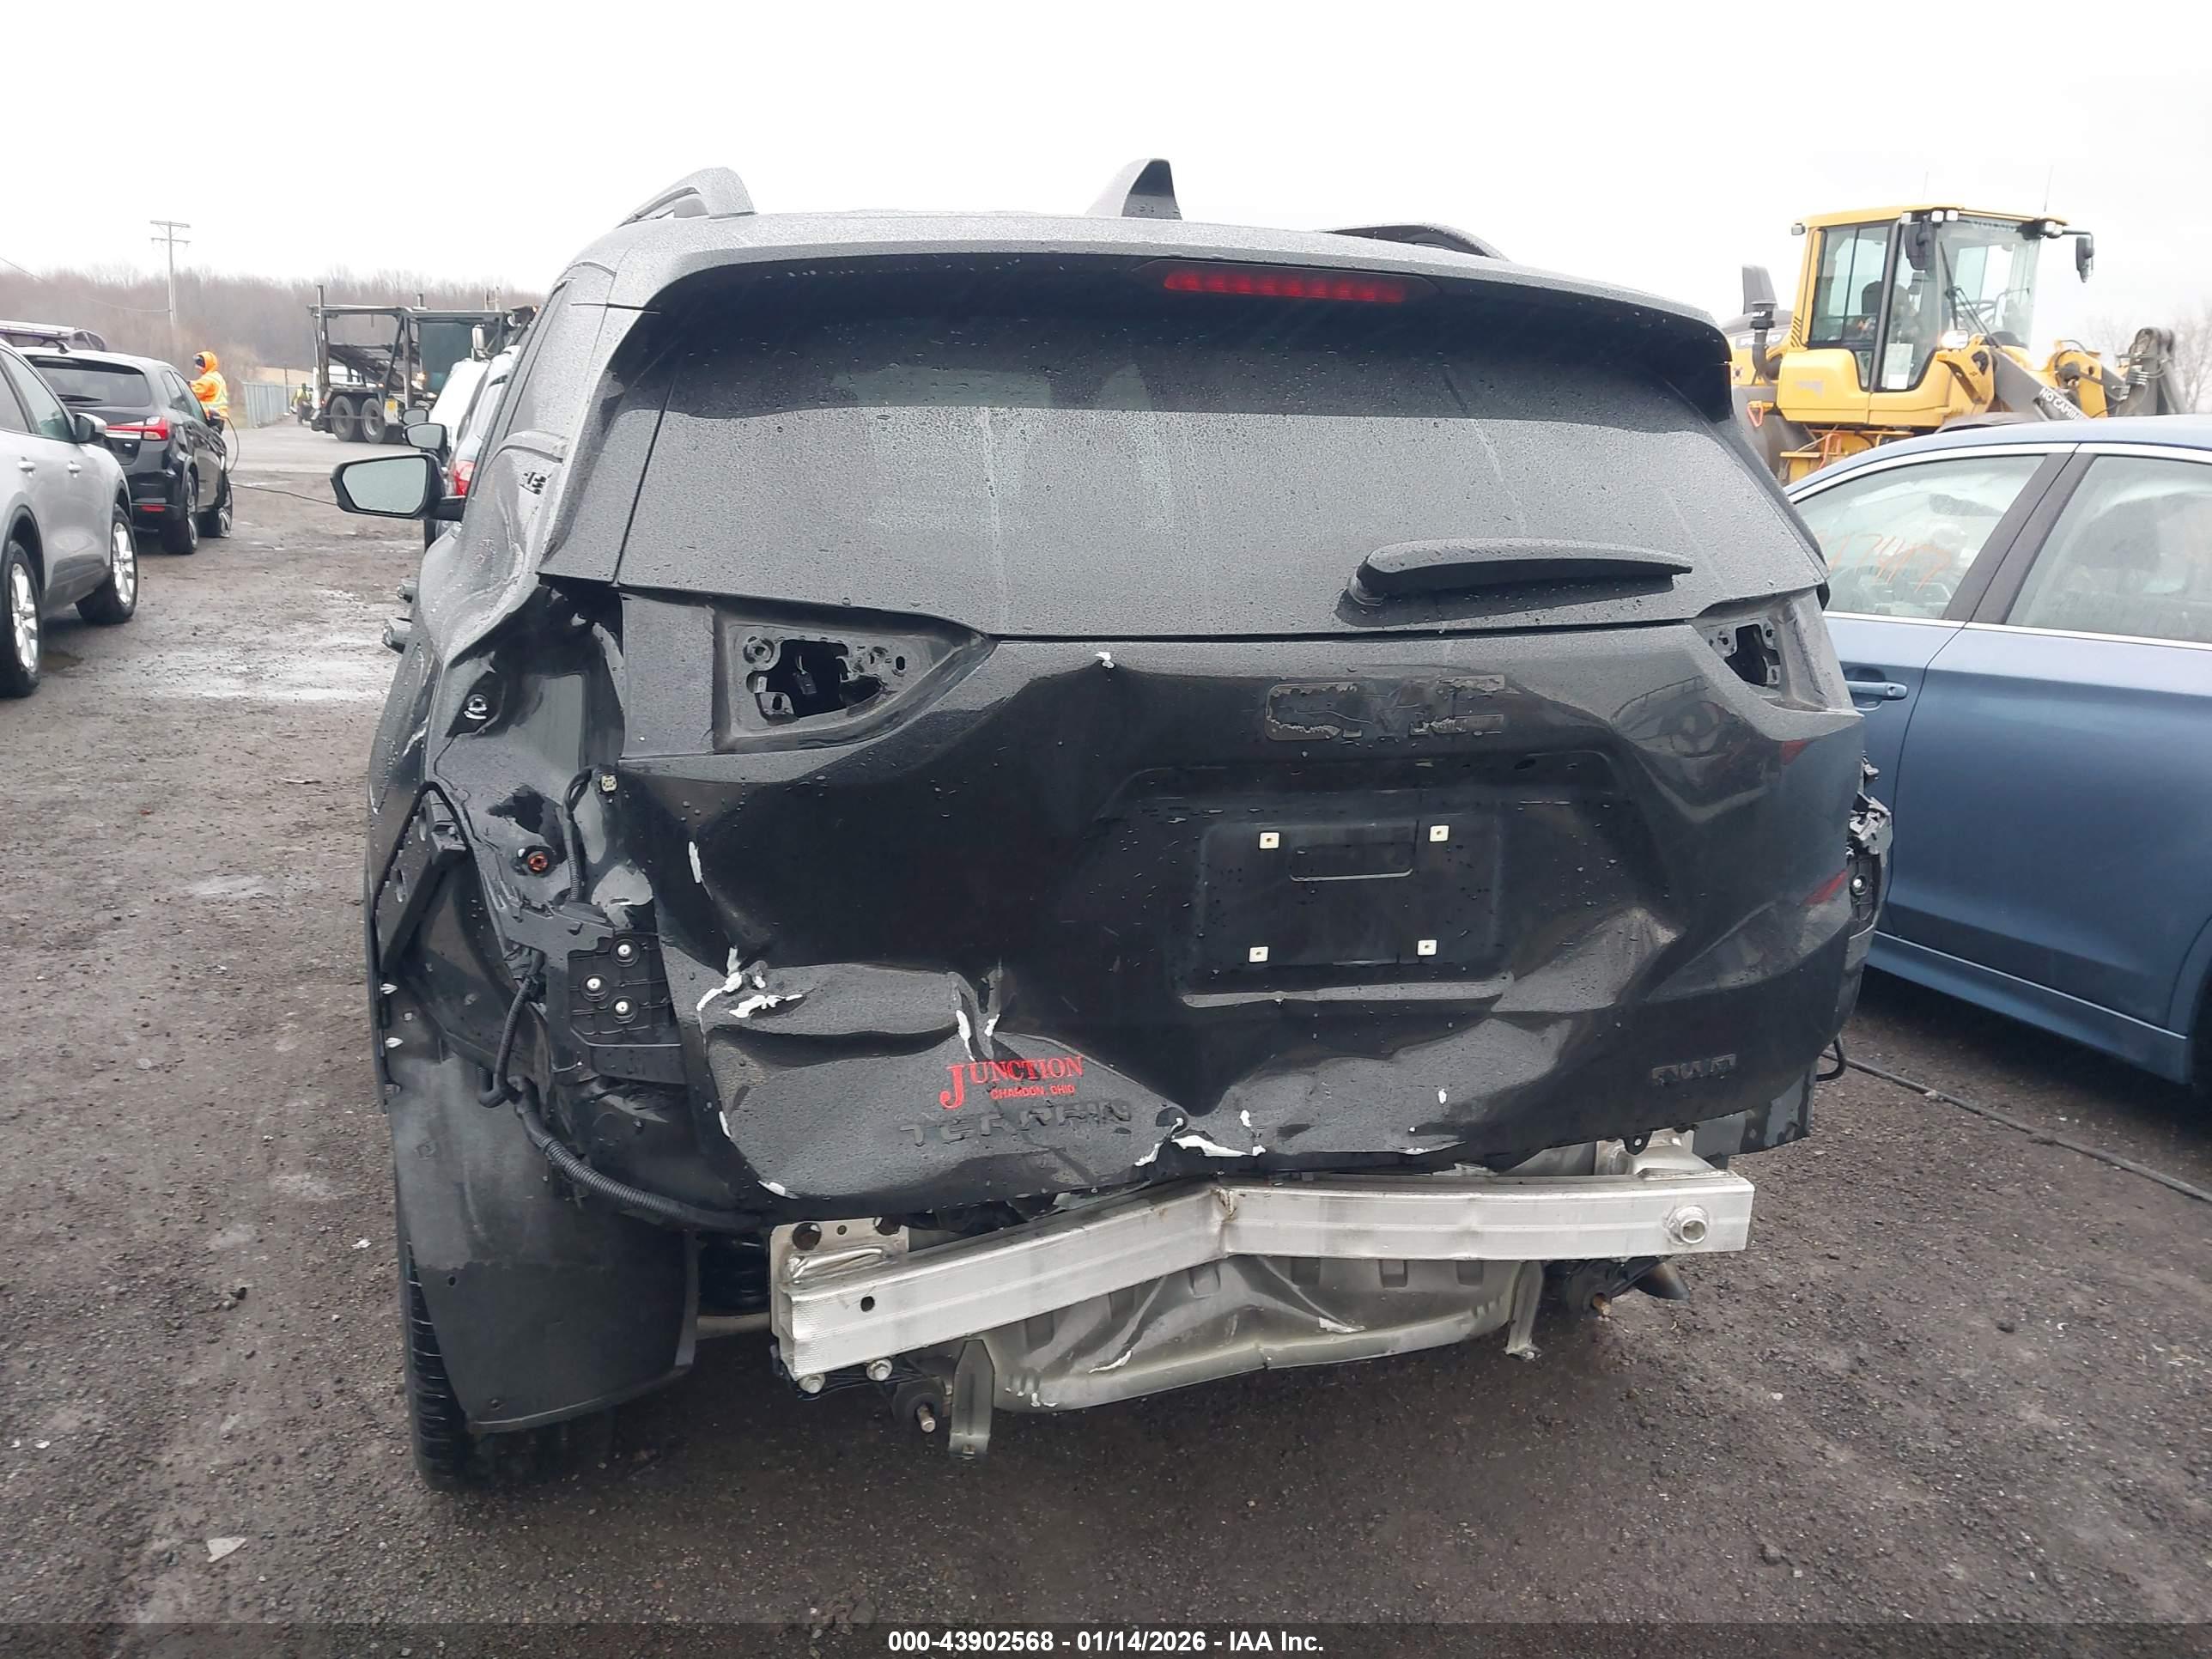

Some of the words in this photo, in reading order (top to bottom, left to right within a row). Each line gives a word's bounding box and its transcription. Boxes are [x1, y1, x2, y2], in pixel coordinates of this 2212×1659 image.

[2039, 387, 2054, 402] NO
[939, 1054, 1084, 1109] JUNCTION
[1050, 1085, 1075, 1096] OHIO
